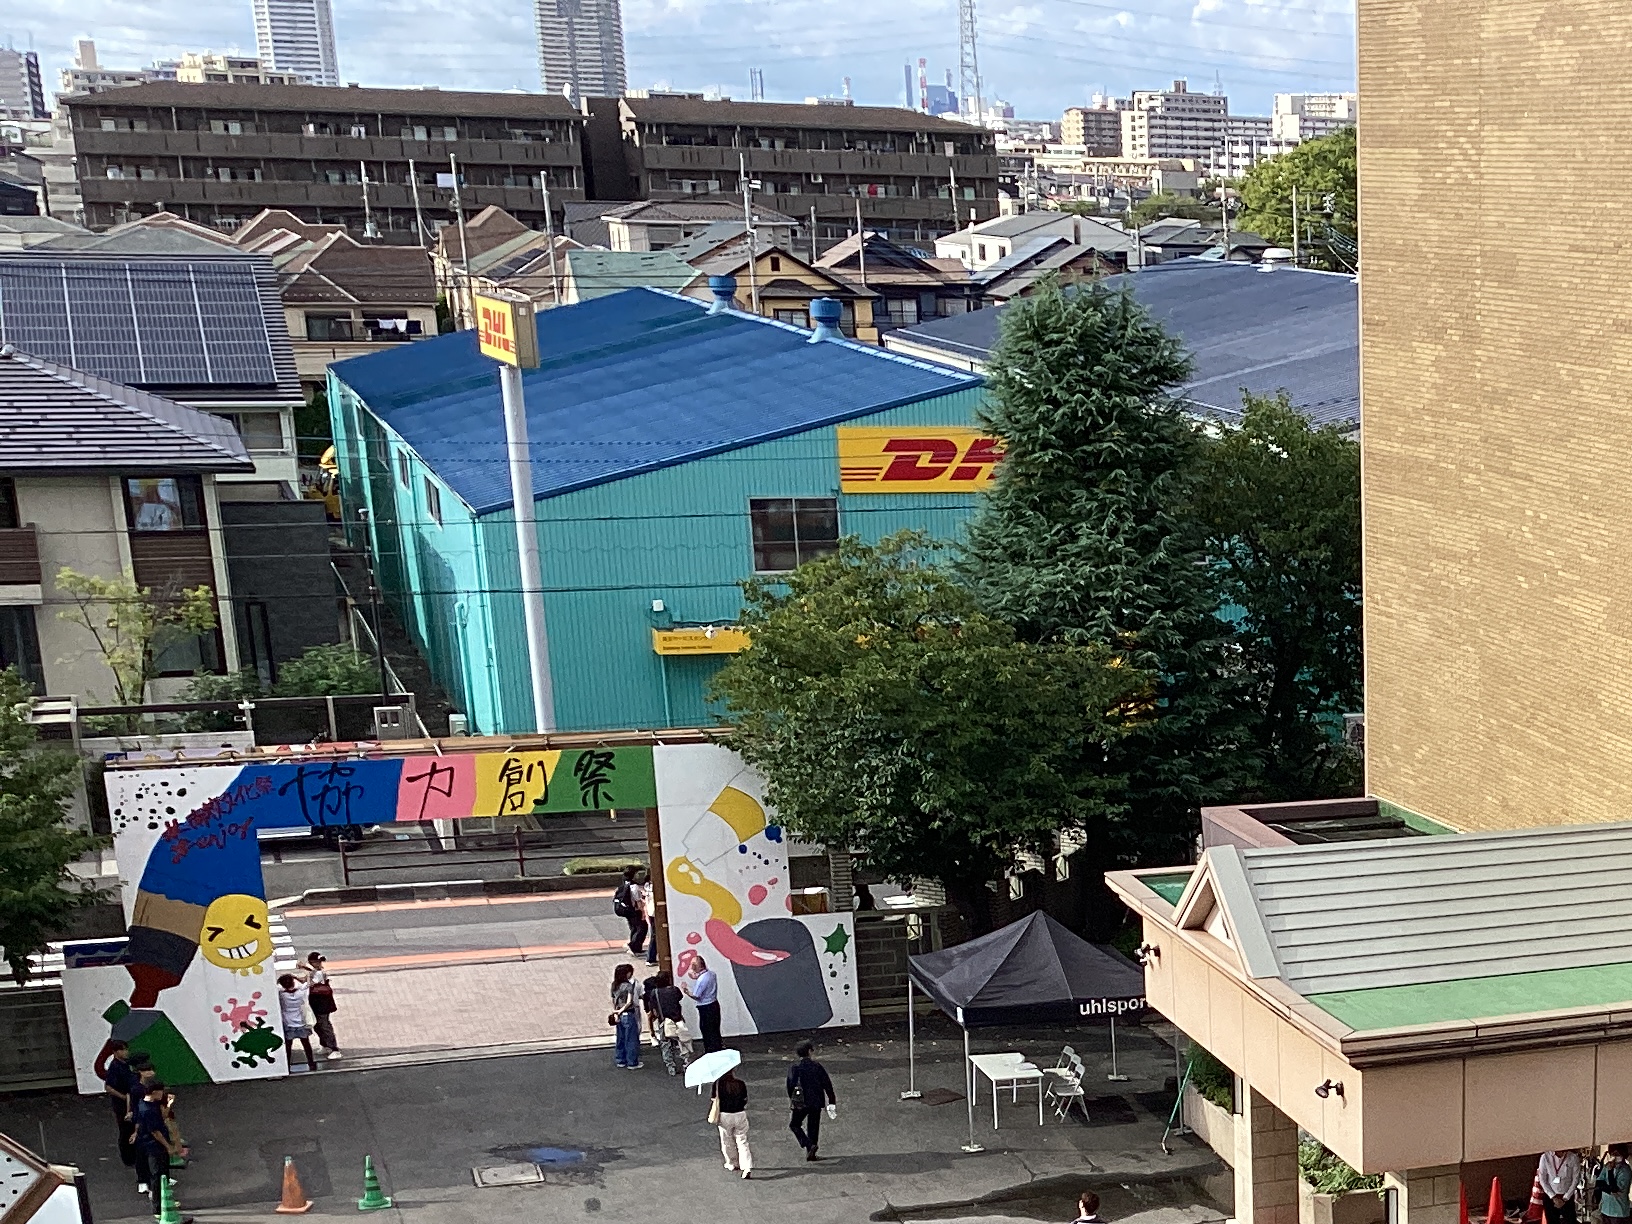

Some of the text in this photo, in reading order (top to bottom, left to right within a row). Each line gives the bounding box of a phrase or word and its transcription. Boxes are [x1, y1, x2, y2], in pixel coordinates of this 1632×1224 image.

[482, 306, 510, 352] DHL
[881, 438, 1005, 481] DH
[1079, 997, 1153, 1016] uhlspor
